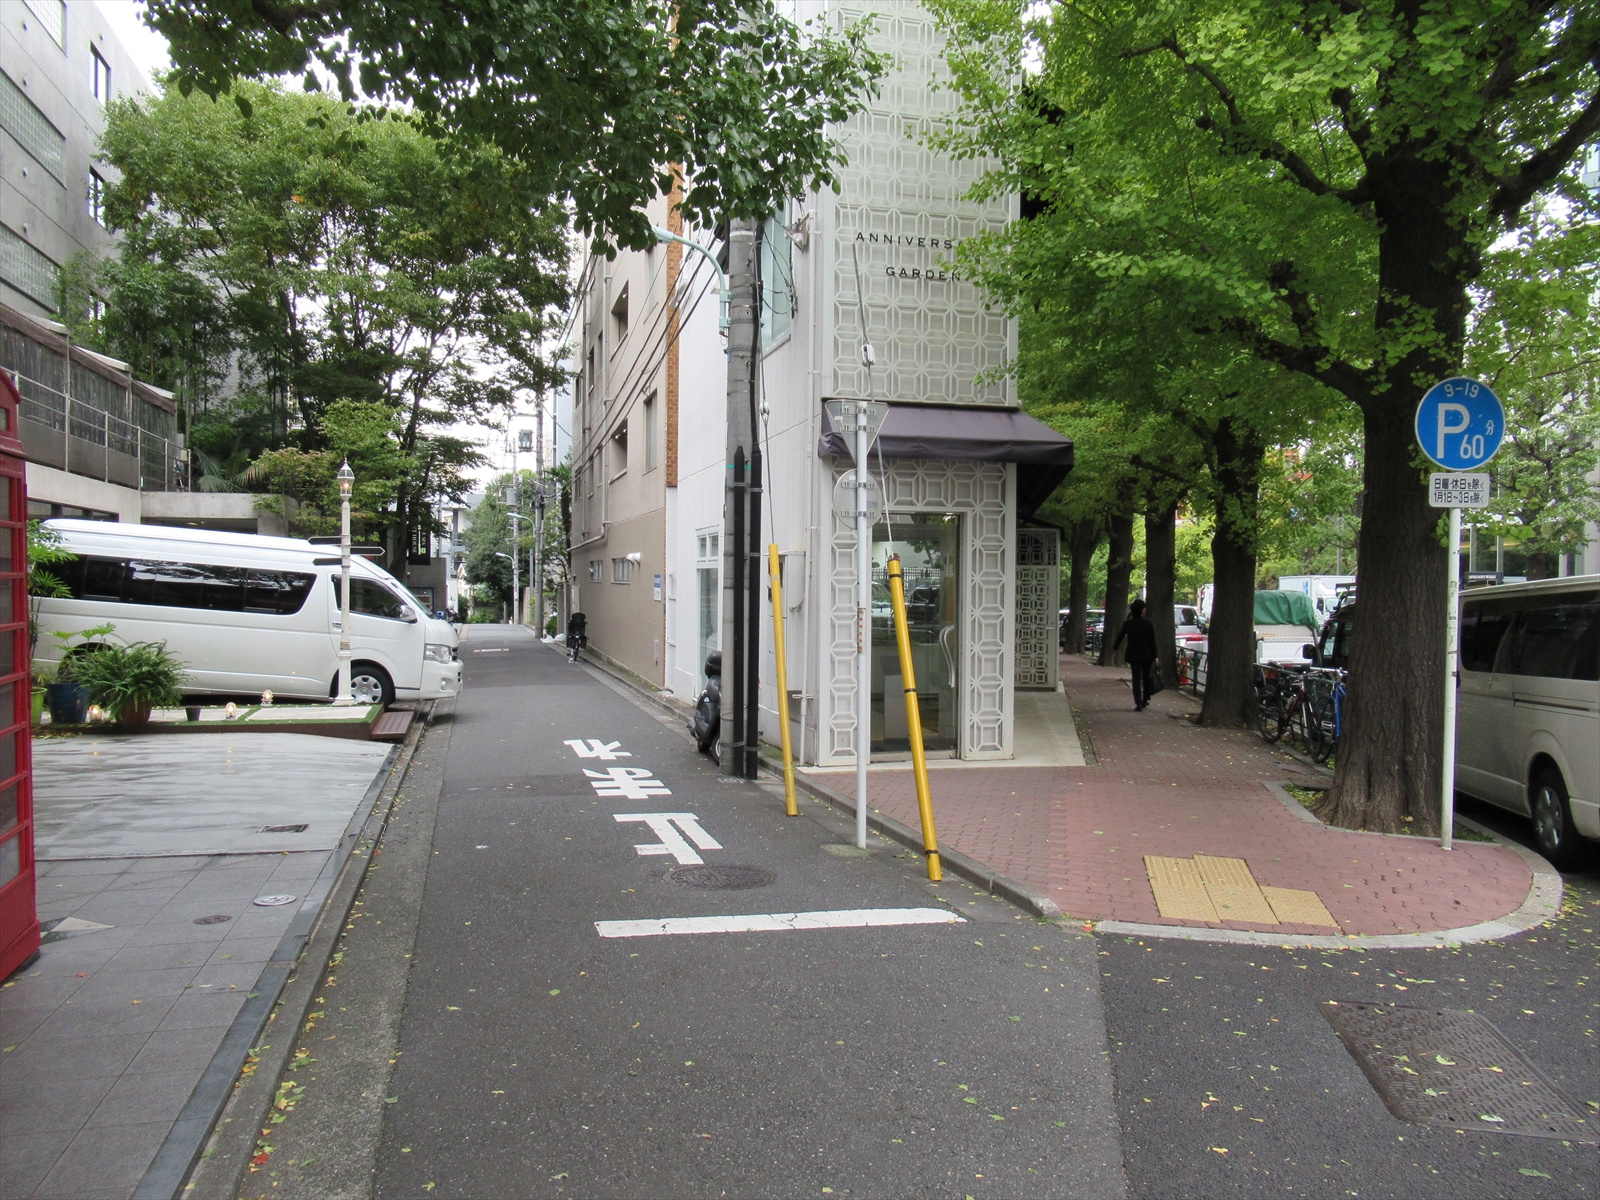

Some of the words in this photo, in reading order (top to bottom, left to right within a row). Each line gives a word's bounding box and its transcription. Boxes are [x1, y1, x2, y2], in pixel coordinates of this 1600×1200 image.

[886, 266, 960, 281] GARDEN
[1444, 382, 1480, 398] 9-19
[1437, 402, 1471, 459] P
